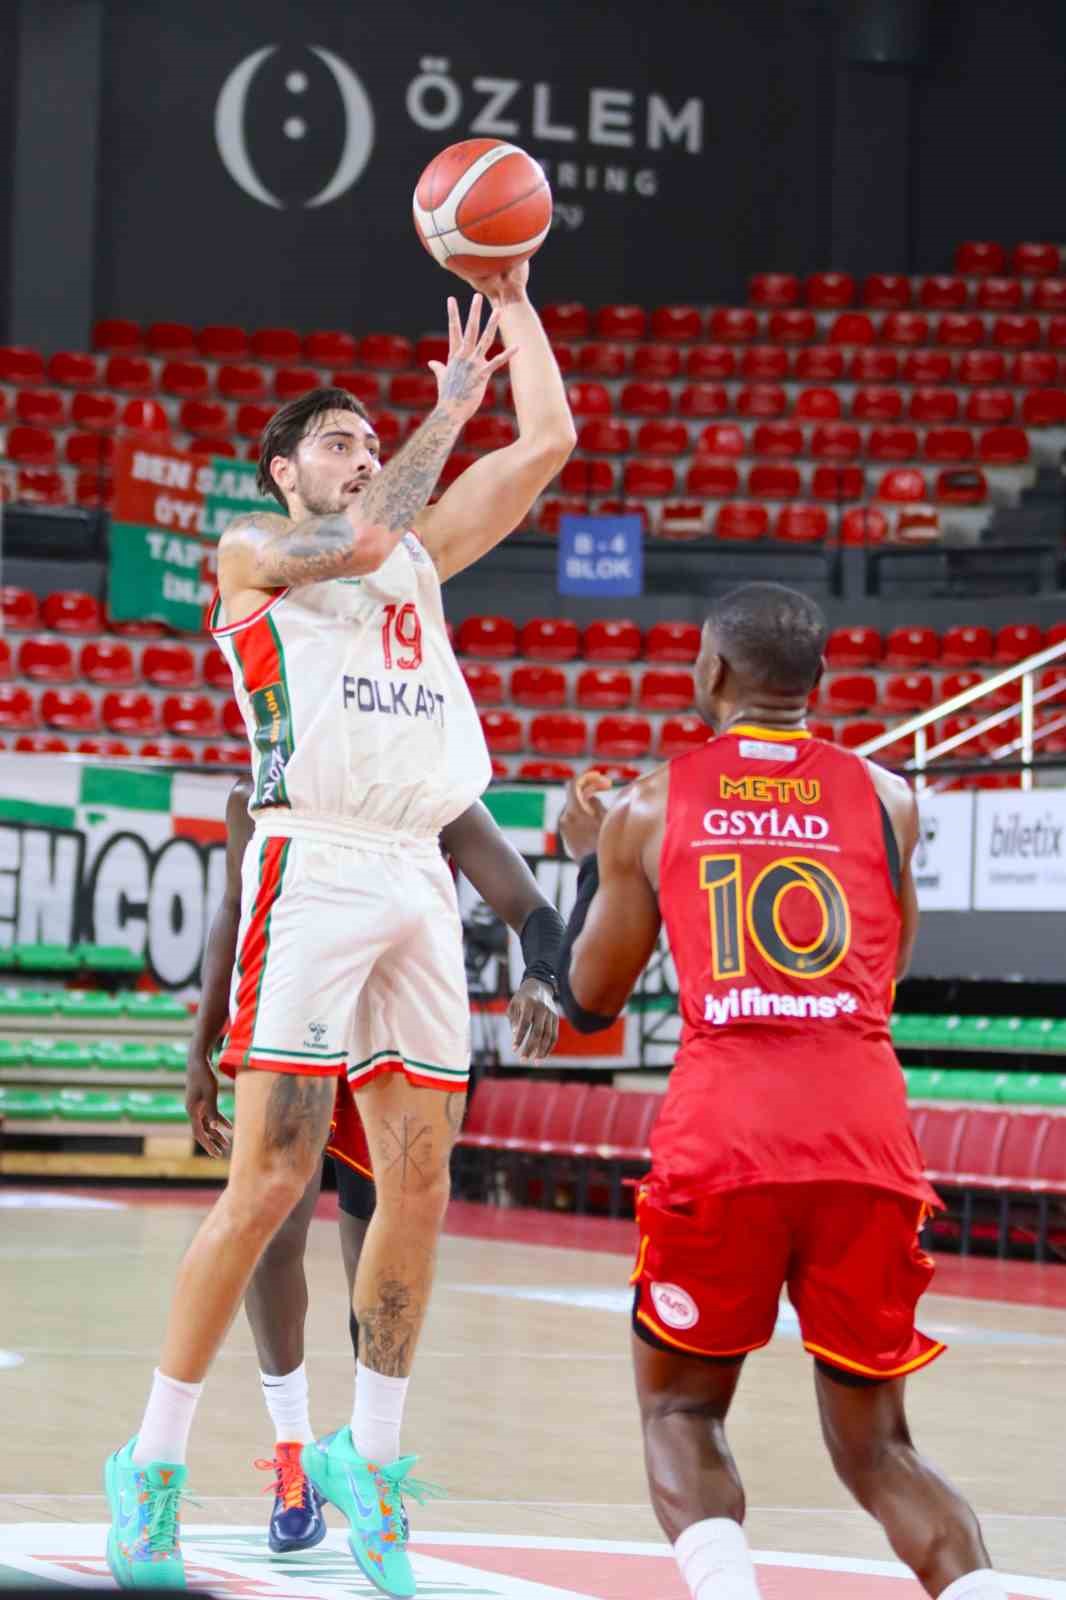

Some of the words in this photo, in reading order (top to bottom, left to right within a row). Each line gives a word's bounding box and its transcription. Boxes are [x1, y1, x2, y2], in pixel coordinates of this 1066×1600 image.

[405, 57, 704, 155] ÖZLEM
[553, 161, 658, 196] RING
[195, 466, 262, 503] SAN
[565, 557, 633, 580] BLOK
[382, 602, 423, 670] 19
[719, 773, 821, 805] METU
[703, 808, 829, 840] GSYİAD
[989, 811, 1063, 858] biletix
[700, 853, 852, 981] 10
